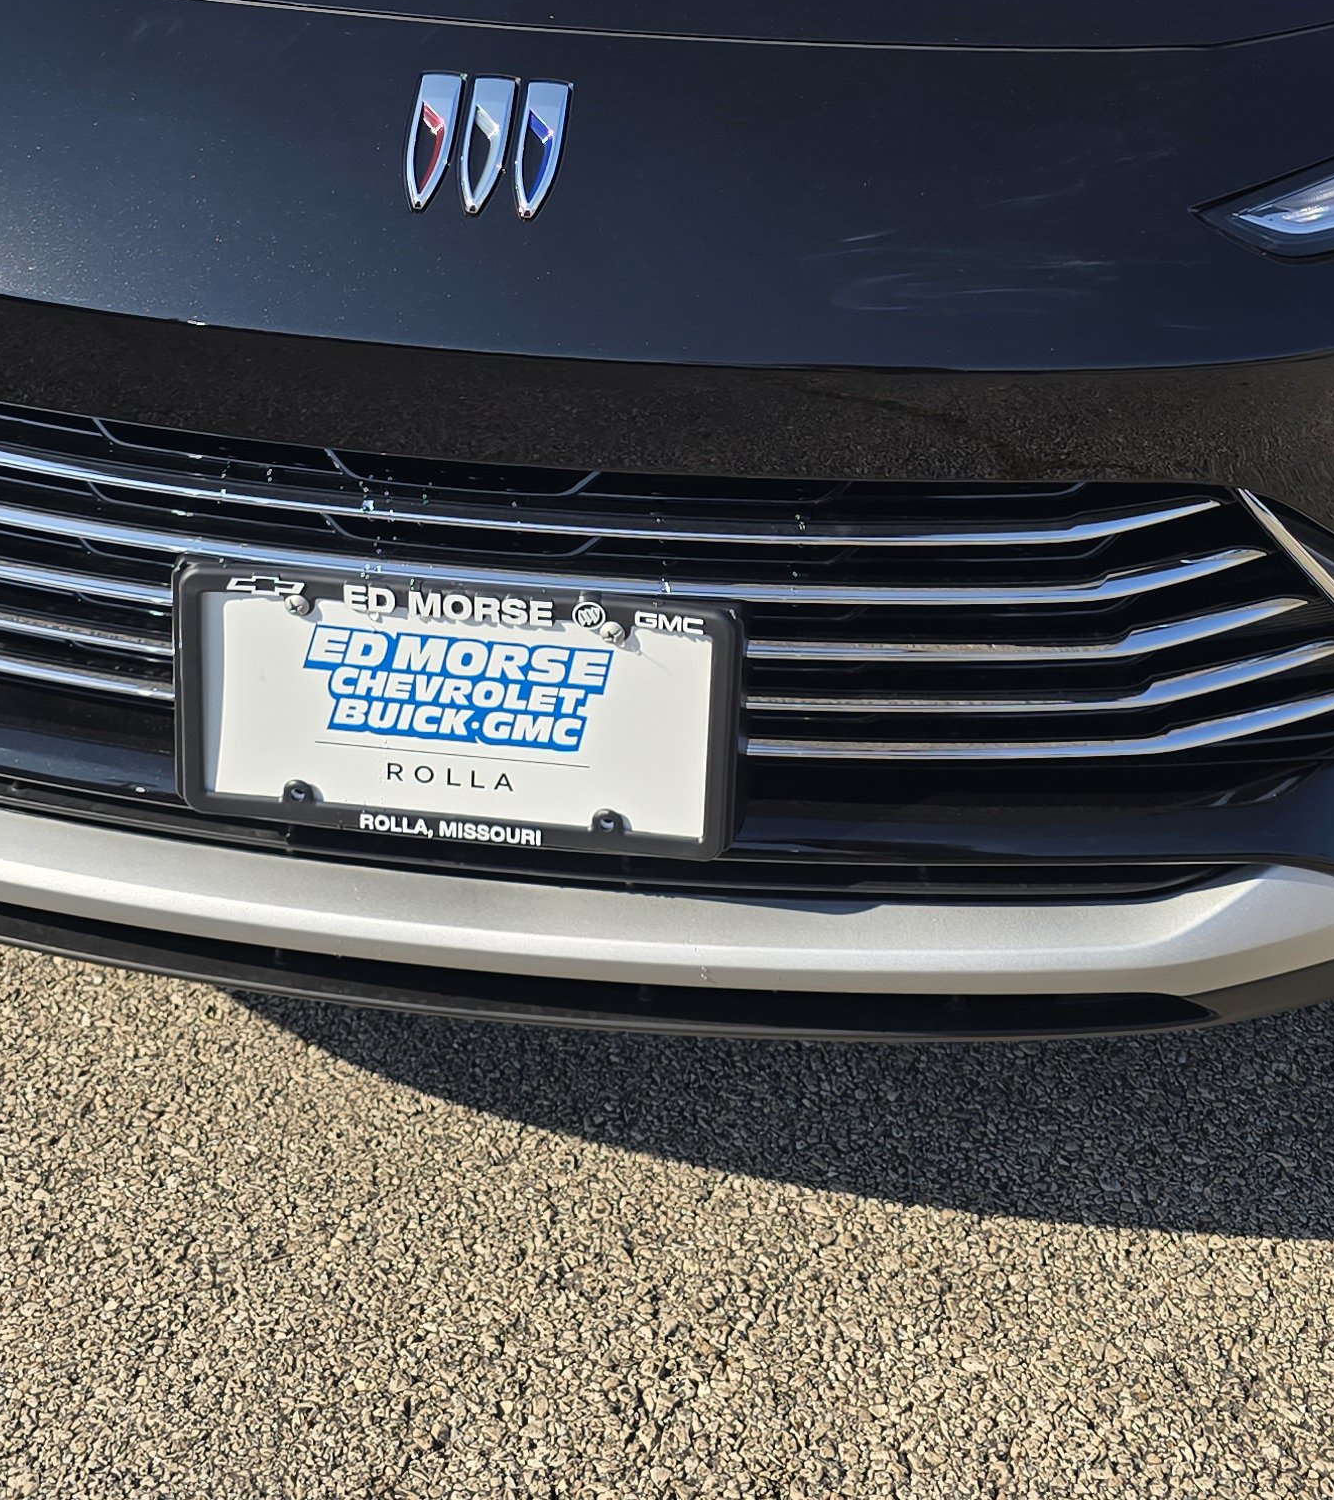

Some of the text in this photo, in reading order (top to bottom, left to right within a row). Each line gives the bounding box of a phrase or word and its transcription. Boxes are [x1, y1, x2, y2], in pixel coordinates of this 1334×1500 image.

[343, 584, 705, 636] ED MORSE GMC
[307, 626, 611, 687] ED MORSE
[330, 666, 586, 715] CHEVROLET
[386, 762, 515, 793] ROLLA
[359, 813, 543, 847] ROLLA, MISSOURI
